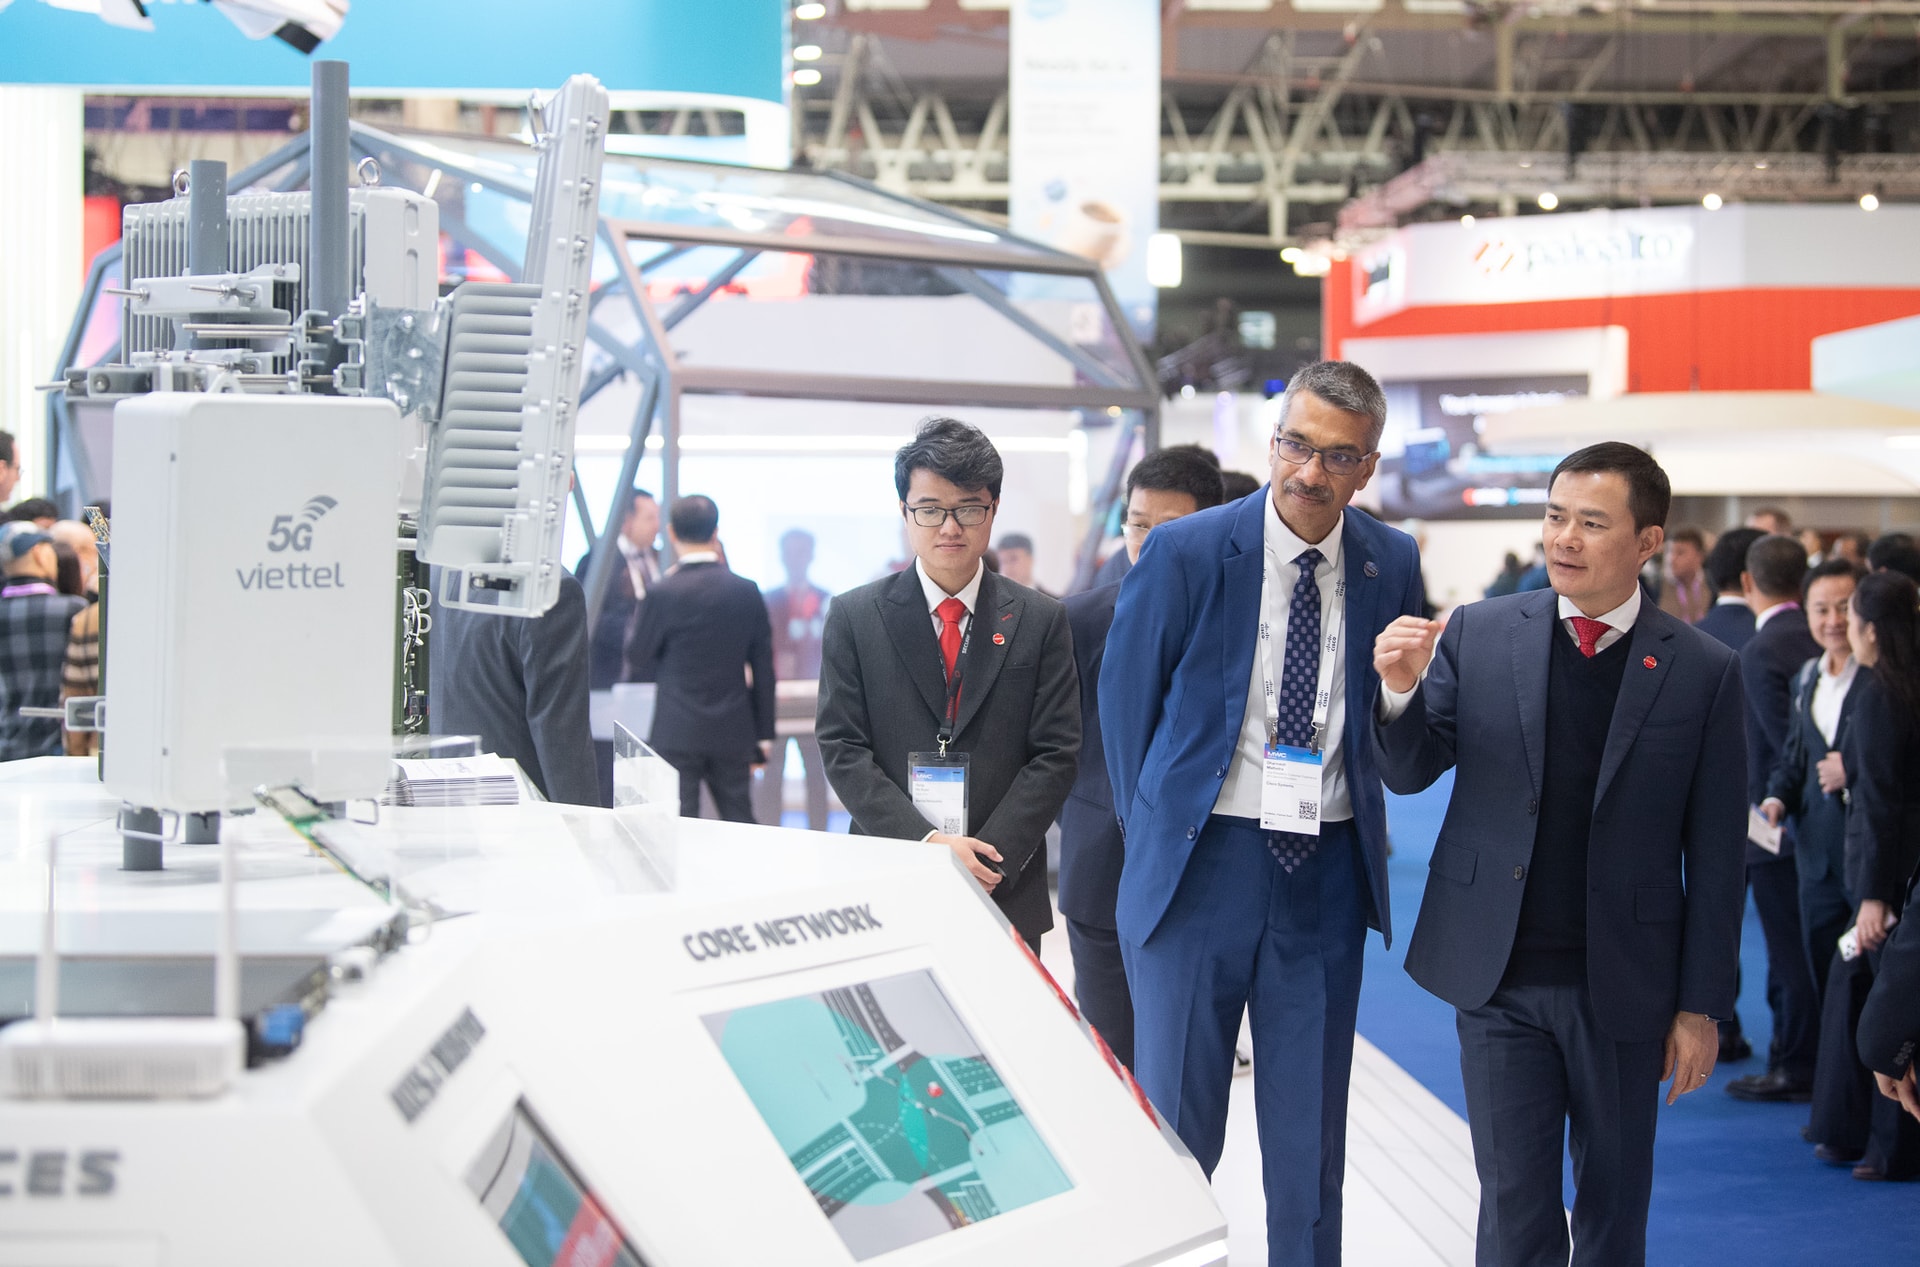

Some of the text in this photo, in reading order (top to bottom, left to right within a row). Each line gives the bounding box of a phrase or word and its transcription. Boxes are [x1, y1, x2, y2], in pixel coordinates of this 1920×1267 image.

[267, 514, 313, 552] 5G
[236, 561, 345, 590] viettel
[682, 903, 883, 961] CORE NETWORK
